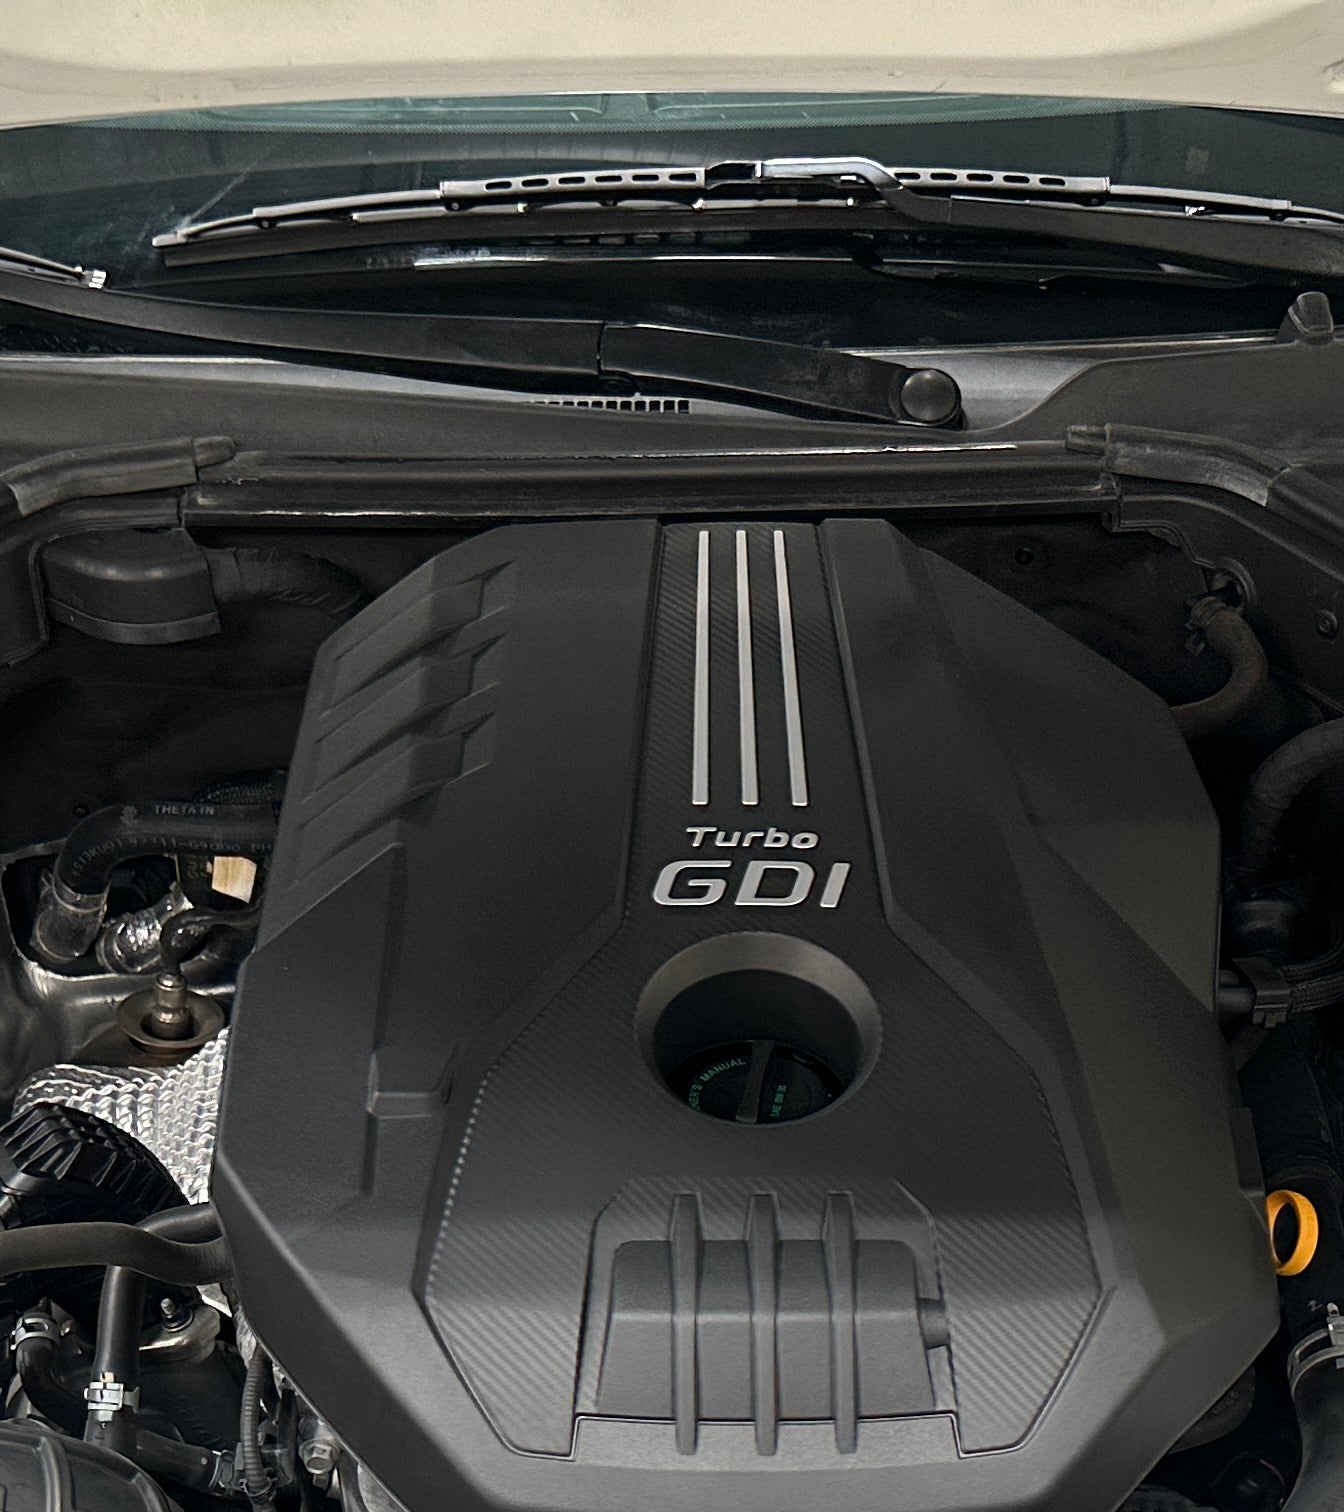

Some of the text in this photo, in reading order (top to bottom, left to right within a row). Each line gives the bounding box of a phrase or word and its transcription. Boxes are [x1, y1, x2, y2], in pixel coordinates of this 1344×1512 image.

[686, 826, 820, 849] Turbo
[652, 859, 852, 909] GDI
[699, 1057, 747, 1083] MANUAL
